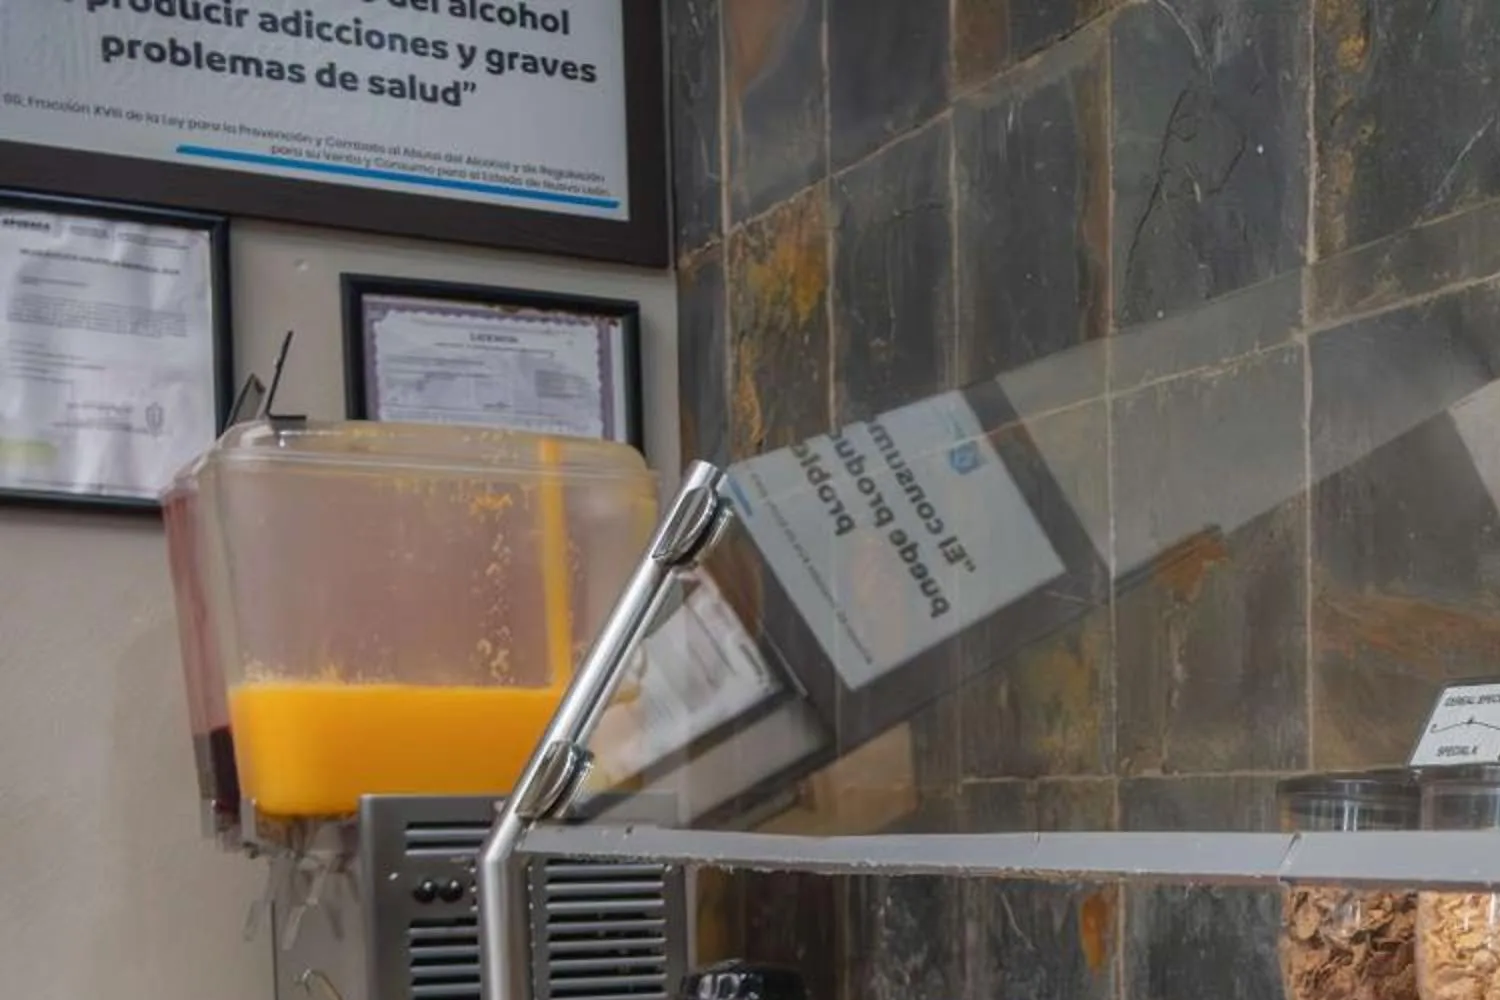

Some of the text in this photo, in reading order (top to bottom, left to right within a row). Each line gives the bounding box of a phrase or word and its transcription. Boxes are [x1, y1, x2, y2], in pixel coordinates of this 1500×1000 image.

[448, 0, 571, 35] alcohol
[101, 35, 306, 84] problemas
[315, 62, 359, 91] de
[258, 10, 449, 60] adicciones
[456, 42, 477, 70] y
[485, 48, 598, 83] graves
[126, 110, 143, 122] de
